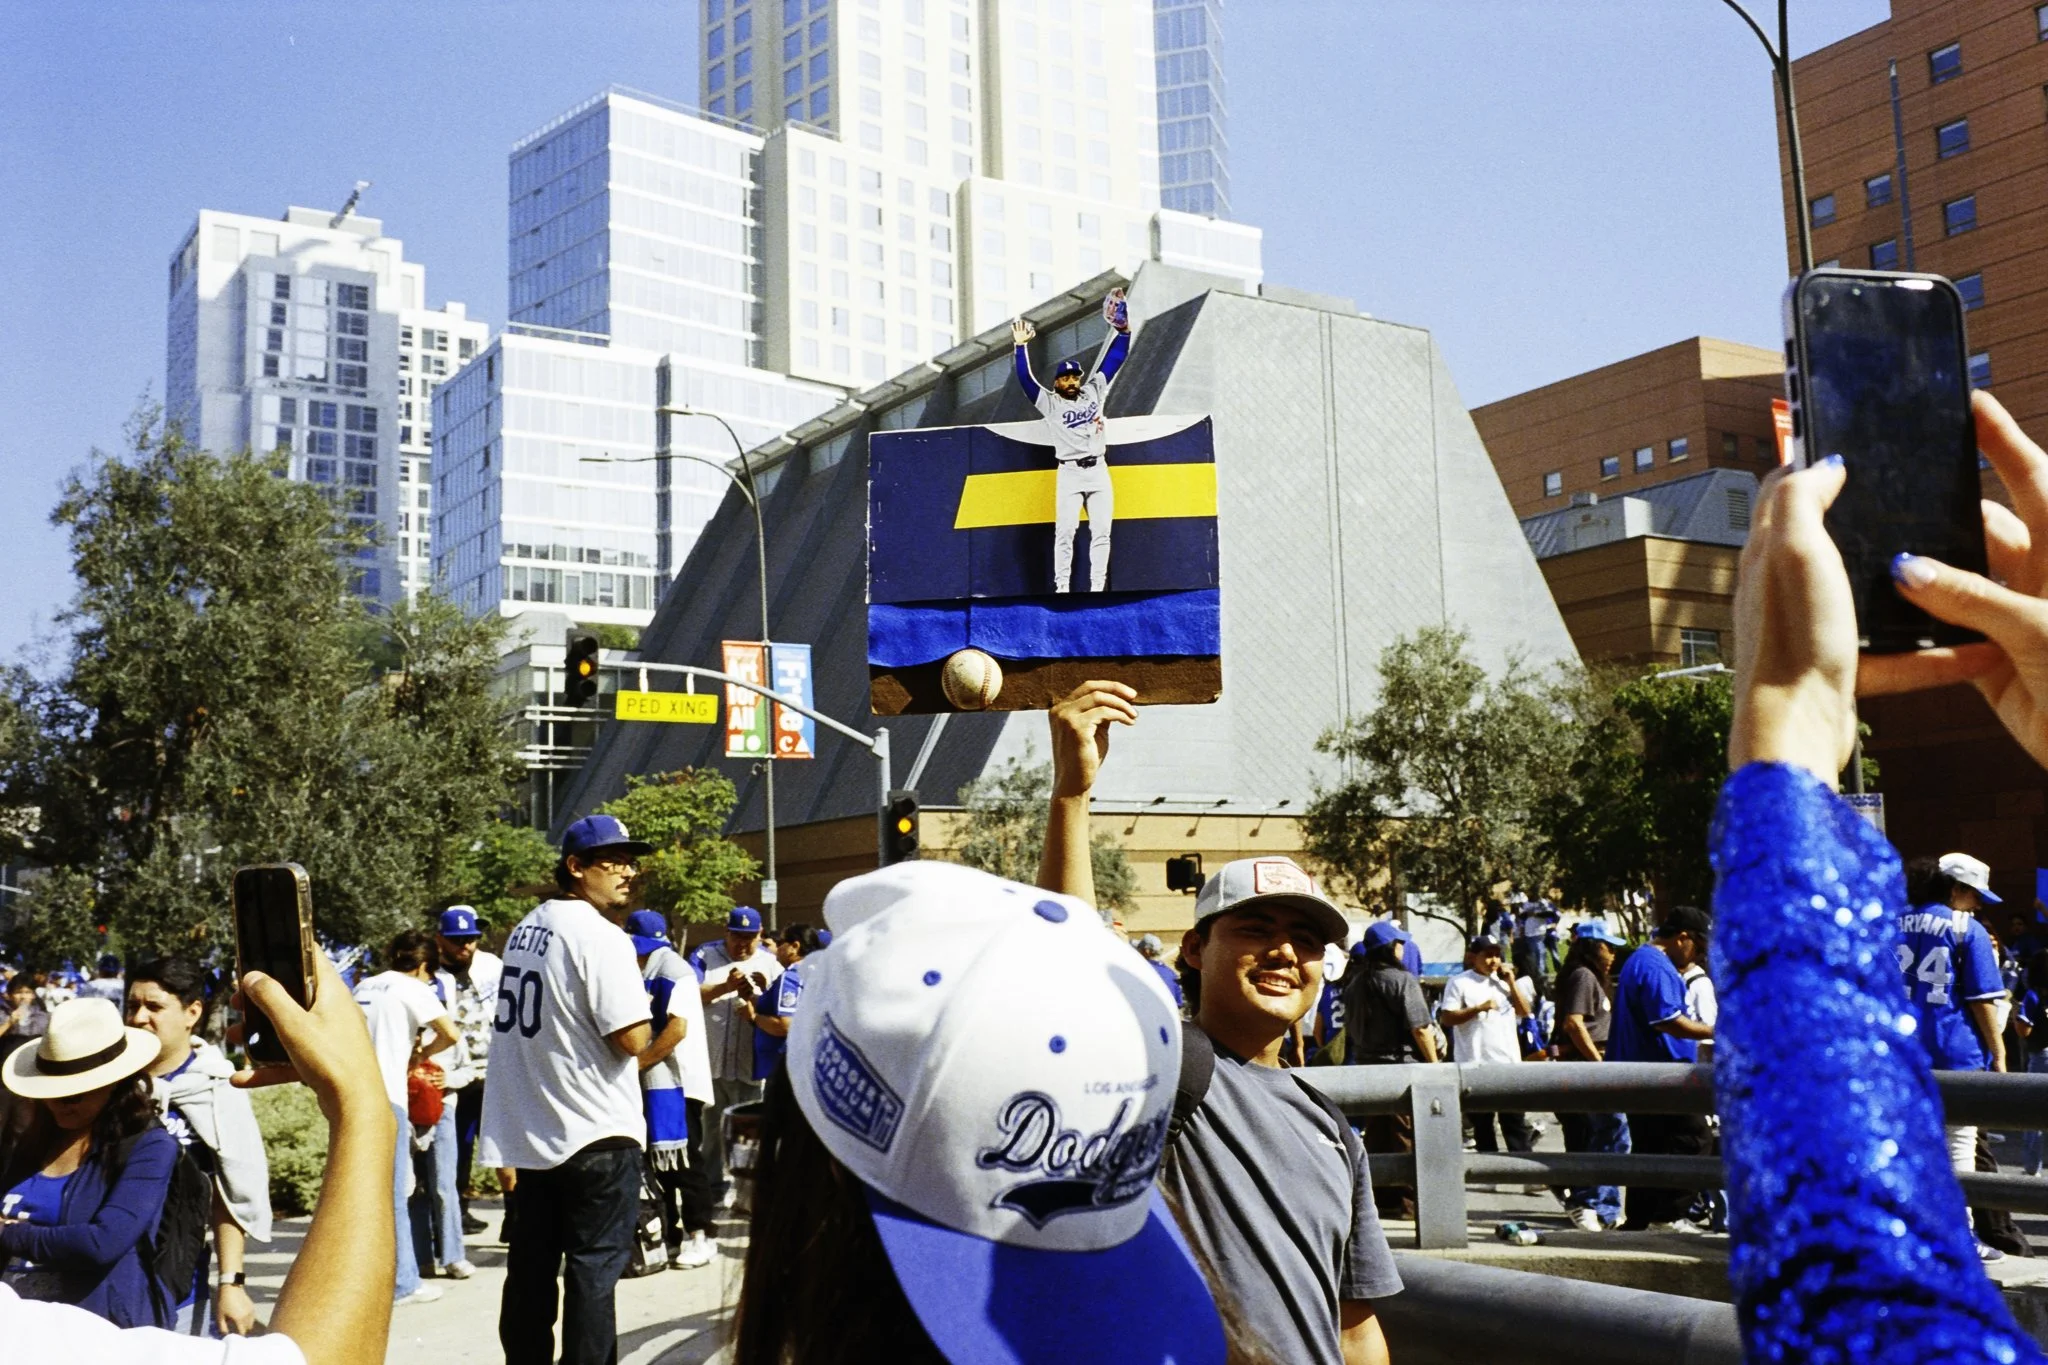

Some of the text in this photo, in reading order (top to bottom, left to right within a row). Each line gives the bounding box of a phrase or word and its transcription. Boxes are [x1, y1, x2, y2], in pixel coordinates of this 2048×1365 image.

[627, 698, 708, 716] PED XING
[729, 705, 756, 730] All
[508, 925, 554, 957] BETTS
[494, 964, 544, 1039] 50
[818, 1050, 873, 1118] STADIUM
[825, 1038, 878, 1103] DODGER
[1084, 1081, 1111, 1095] LOS
[976, 1091, 1170, 1206] Dodge
